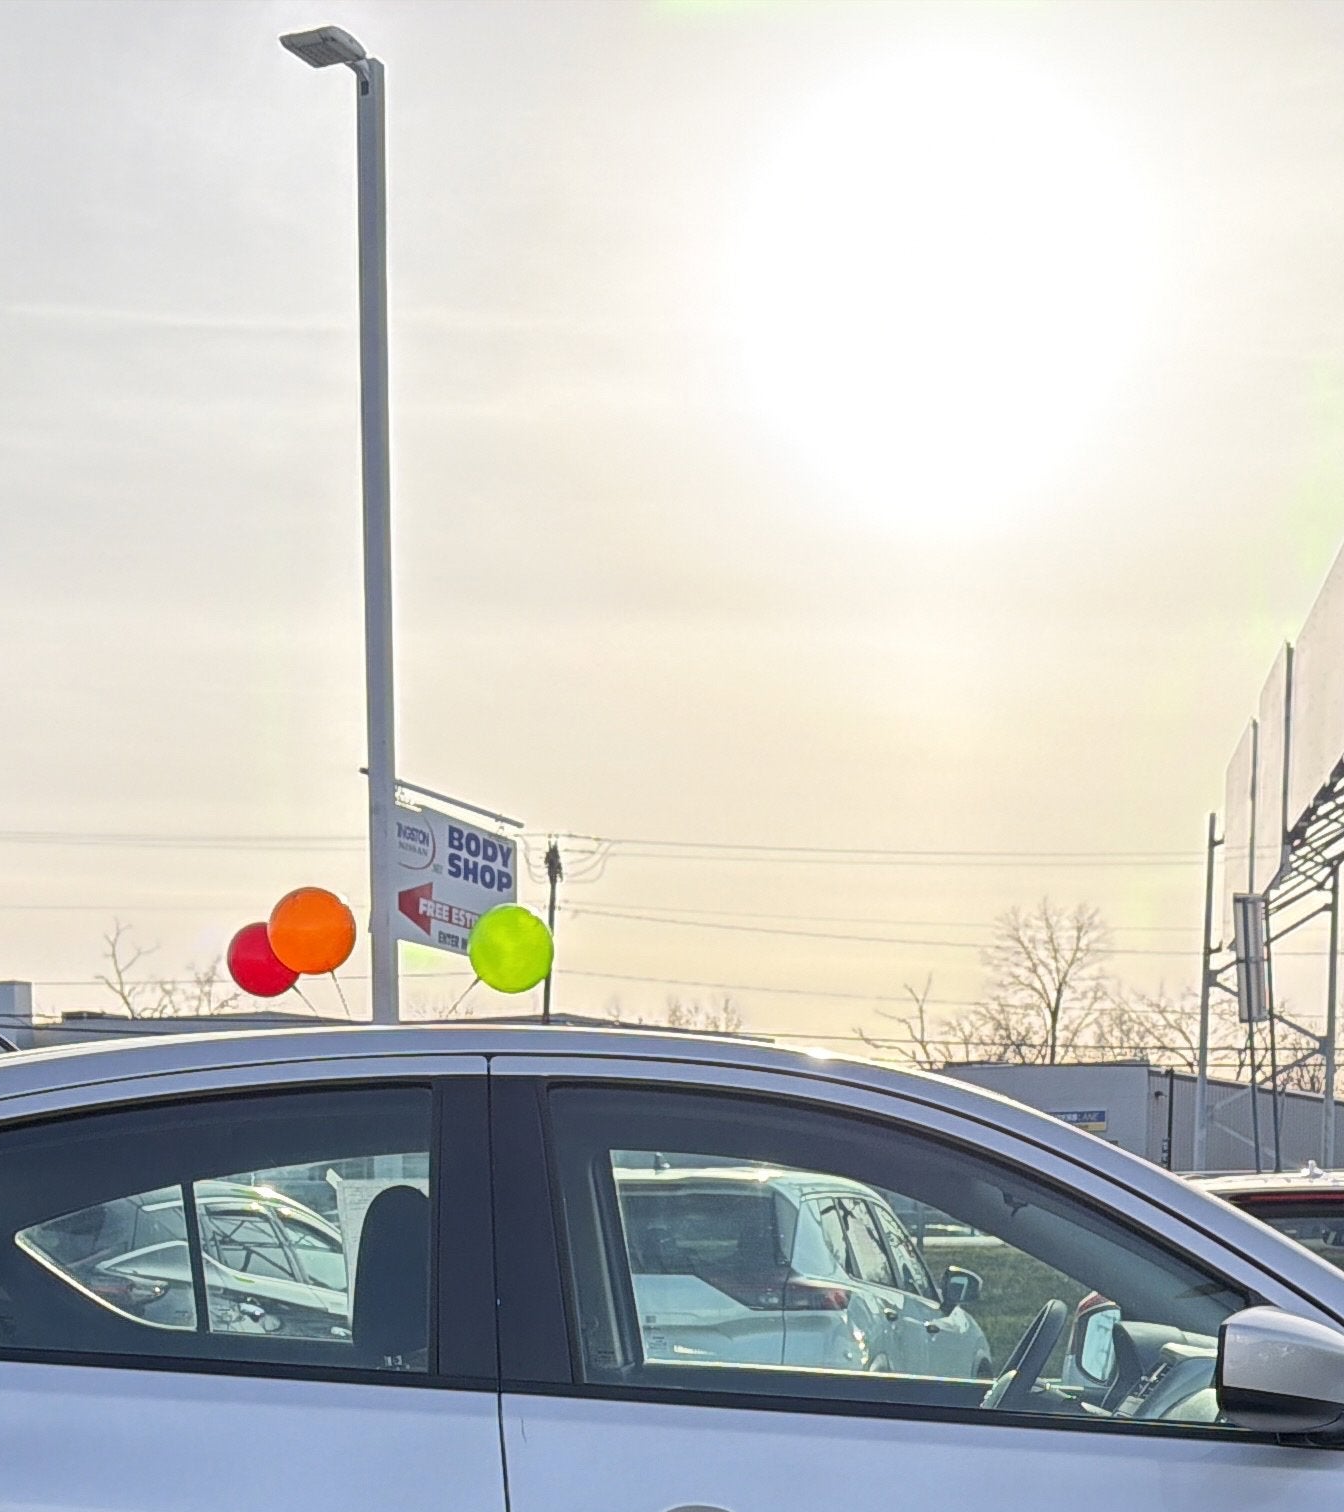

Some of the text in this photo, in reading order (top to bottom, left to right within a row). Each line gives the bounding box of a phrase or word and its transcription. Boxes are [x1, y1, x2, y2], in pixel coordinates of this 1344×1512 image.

[448, 824, 512, 868] BODY
[447, 852, 512, 893] SHOP
[419, 897, 450, 922] FREE
[438, 931, 460, 948] ENTER
